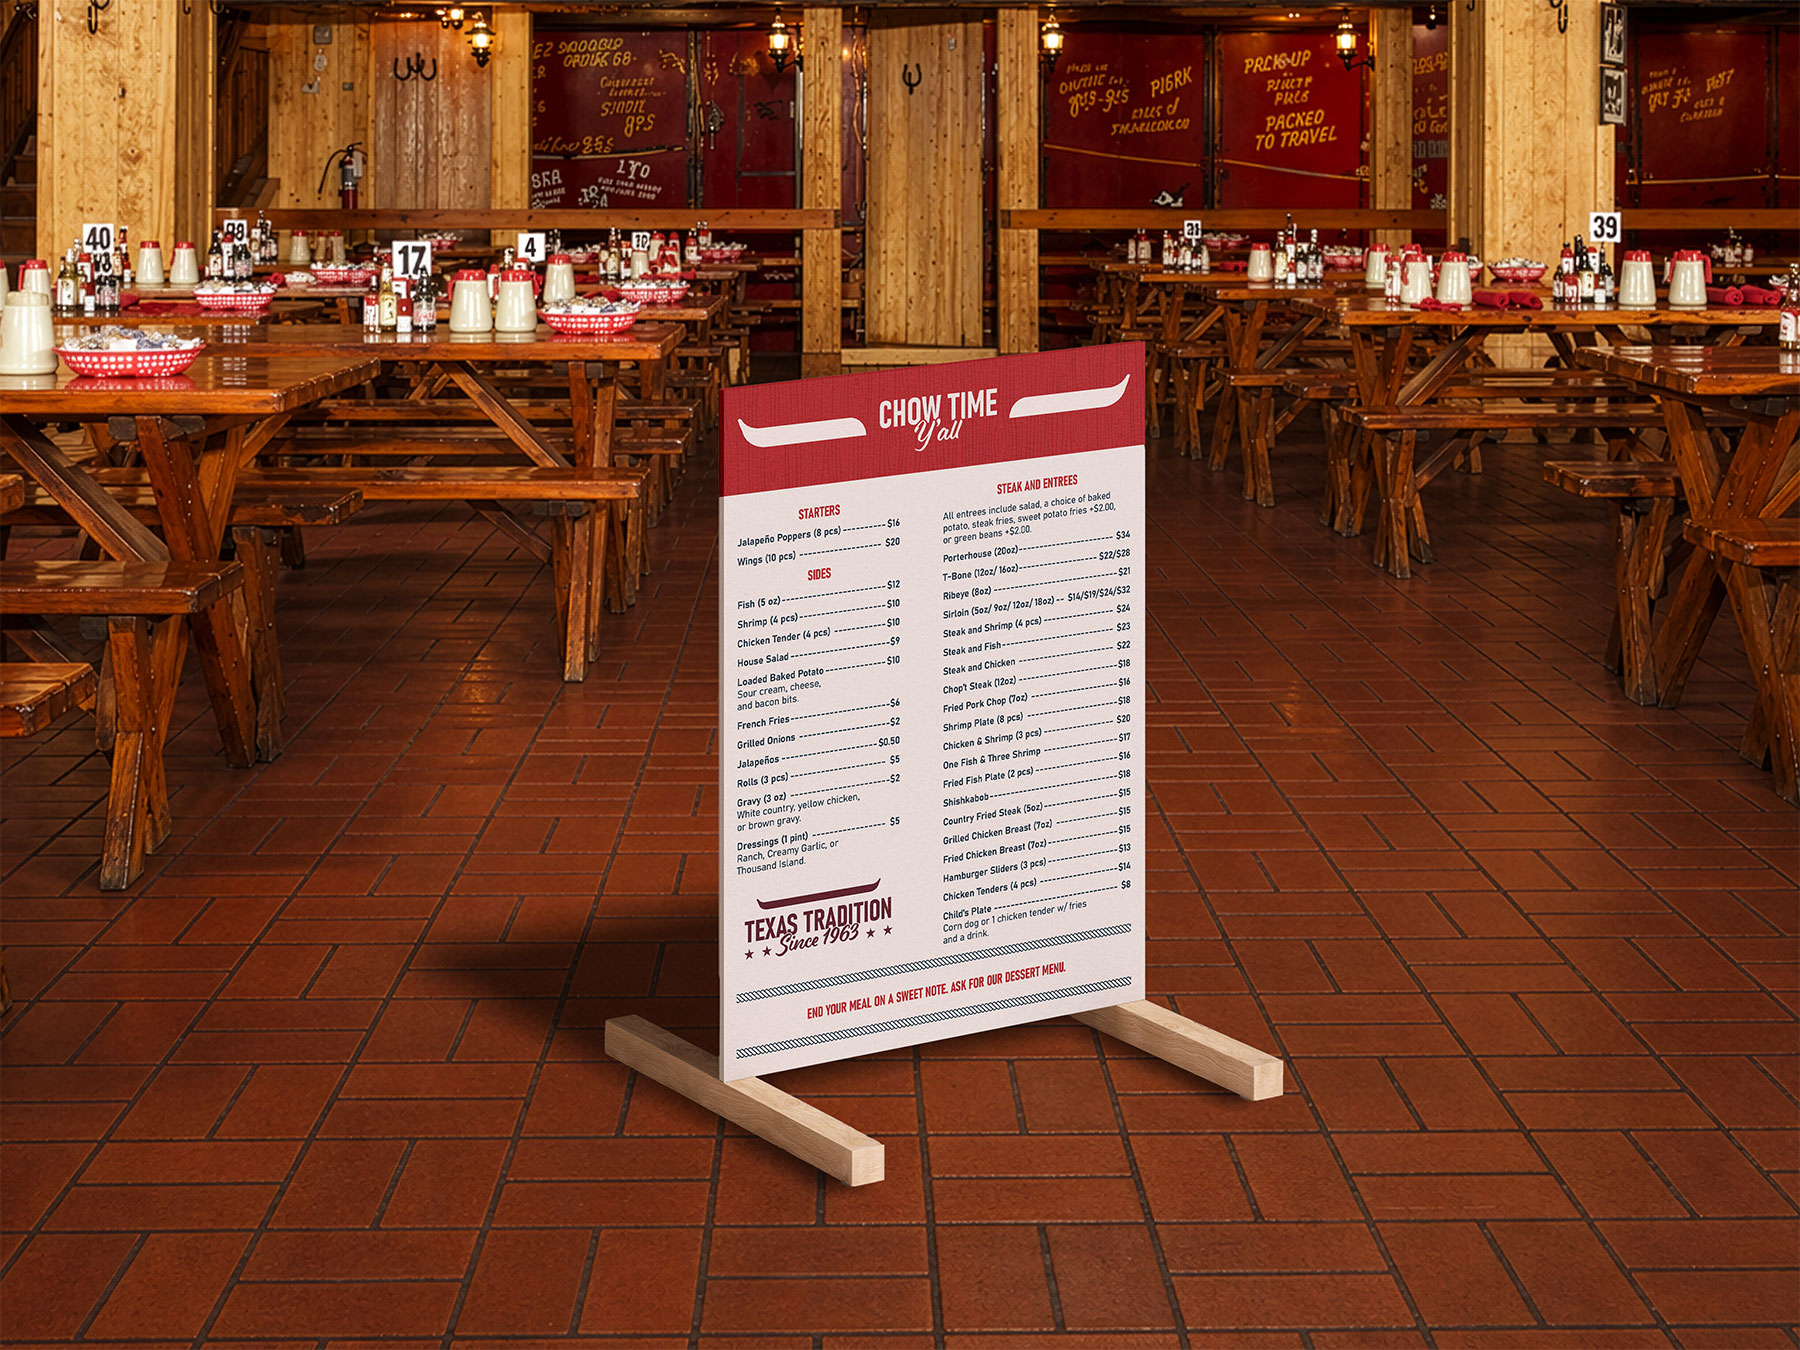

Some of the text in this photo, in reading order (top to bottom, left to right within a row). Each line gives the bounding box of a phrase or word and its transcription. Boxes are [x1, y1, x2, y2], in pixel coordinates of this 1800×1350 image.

[1255, 125, 1338, 151] TO TRAVEL
[86, 227, 110, 250] 40
[1594, 216, 1617, 238] 39
[398, 245, 427, 277] 17
[525, 237, 537, 258] 4
[880, 388, 998, 428] CHOW TIME
[914, 418, 963, 452] Y'all
[996, 473, 1078, 495] STEAK AND ENTREES
[798, 504, 840, 520] STARTERS
[737, 518, 900, 547] Jalapeño Poppers (8 pcs) $16
[943, 530, 1130, 562] Porterhouse (20oz) $34
[736, 536, 900, 566] Wings (10 pcs) $20
[807, 567, 831, 581] SIDES
[942, 571, 972, 581] T-Bone
[998, 563, 1018, 574] 16oz)
[943, 566, 1130, 600] Ribeye (8oz) $21
[737, 579, 900, 609] Fish (5 oz) $12
[943, 608, 969, 619] Sirloin
[1034, 595, 1054, 606] 18oz)
[737, 598, 900, 629] Shrimp (4 pcs) $10
[737, 617, 900, 648] Chicken Tender (4 pcs) $10
[943, 621, 1130, 656] Steak and Fish $23
[737, 636, 900, 667] House Salad $9
[737, 655, 900, 686] Loaded Baked Potato $10
[942, 658, 1130, 694] Chop't Steak (12oz) $18
[736, 695, 799, 711] and bacon bits.
[737, 680, 821, 699] Sour cream, cheese,
[737, 698, 900, 730] French Fries $6
[737, 716, 900, 749] Grilled Onions $2
[736, 735, 900, 768] Jalapeños $0.50
[942, 732, 1130, 769] One Fish & Three Shrimp $17
[737, 754, 900, 788] Rolls (3 pcs) $5
[737, 773, 900, 807] Gravy (3 oz) $2
[943, 768, 1130, 807] Shishkabob $18
[736, 794, 860, 819] White country, yellow chicken,
[748, 819, 774, 829] brown
[776, 815, 801, 827] gravy.
[942, 787, 1130, 826] Country Fried Steak (5oz) $15
[737, 816, 900, 851] Dressings (1 pint) $5
[736, 851, 764, 862] Ranch,
[767, 847, 799, 858] Creamy
[800, 841, 827, 852] Garlic,
[736, 856, 806, 875] Thousand Island.
[943, 842, 1131, 882] Hamburger Sliders (3 pcs) $13
[942, 879, 1131, 920] Child's Plate $8
[744, 896, 892, 943] TEXAS TRADITION
[776, 922, 860, 957] Since 1963
[807, 961, 1066, 1019] END YOUR MEAL ON A SWEET NOTE. ASK FOR OUR DESSERT MENU.
